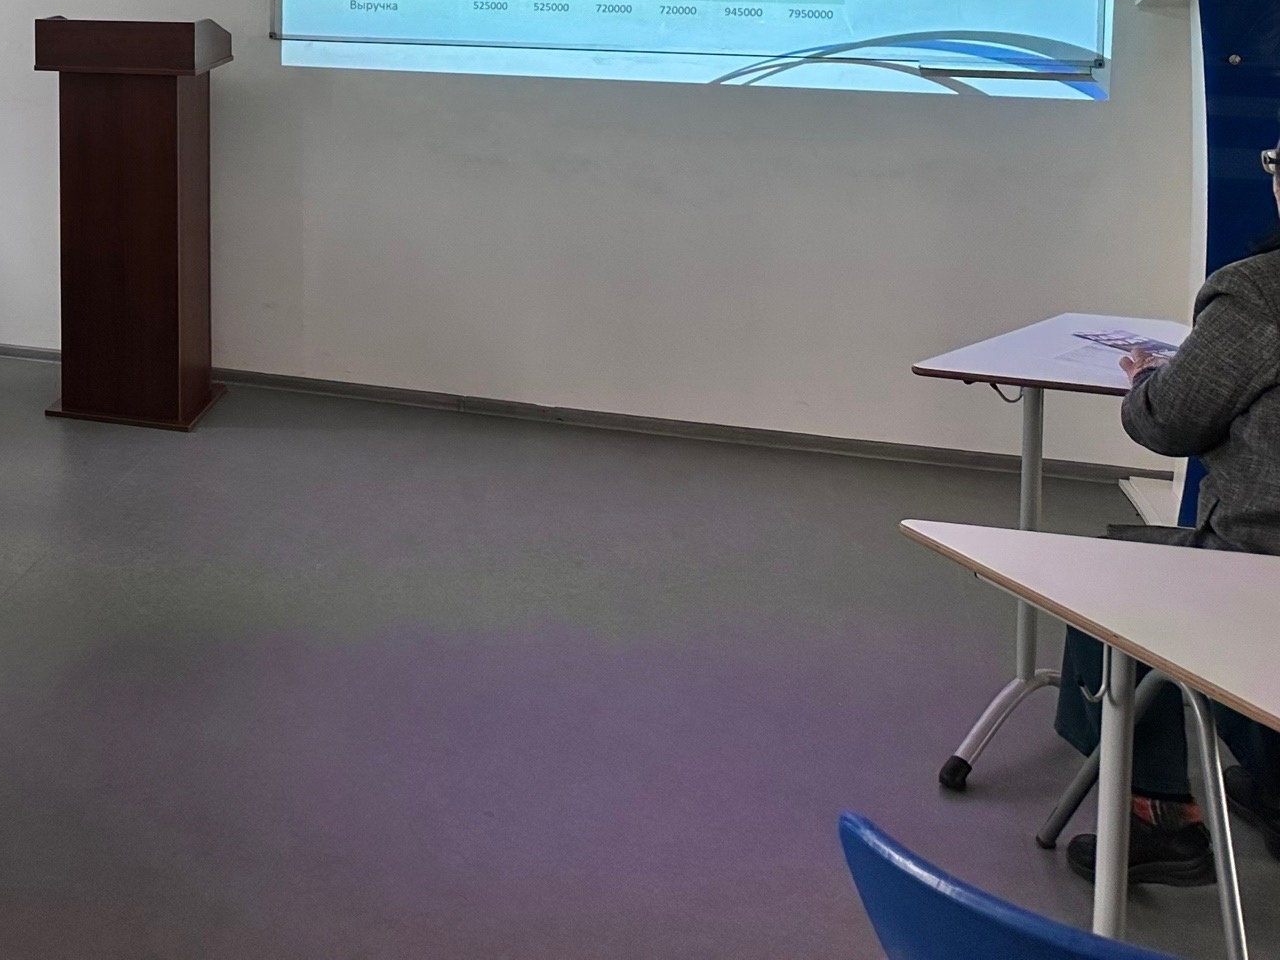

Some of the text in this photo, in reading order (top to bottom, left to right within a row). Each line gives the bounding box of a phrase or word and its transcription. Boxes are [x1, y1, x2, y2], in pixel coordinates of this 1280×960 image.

[350, 0, 834, 19] Выручка 525000 525000 720000 720000 945000 7950000
